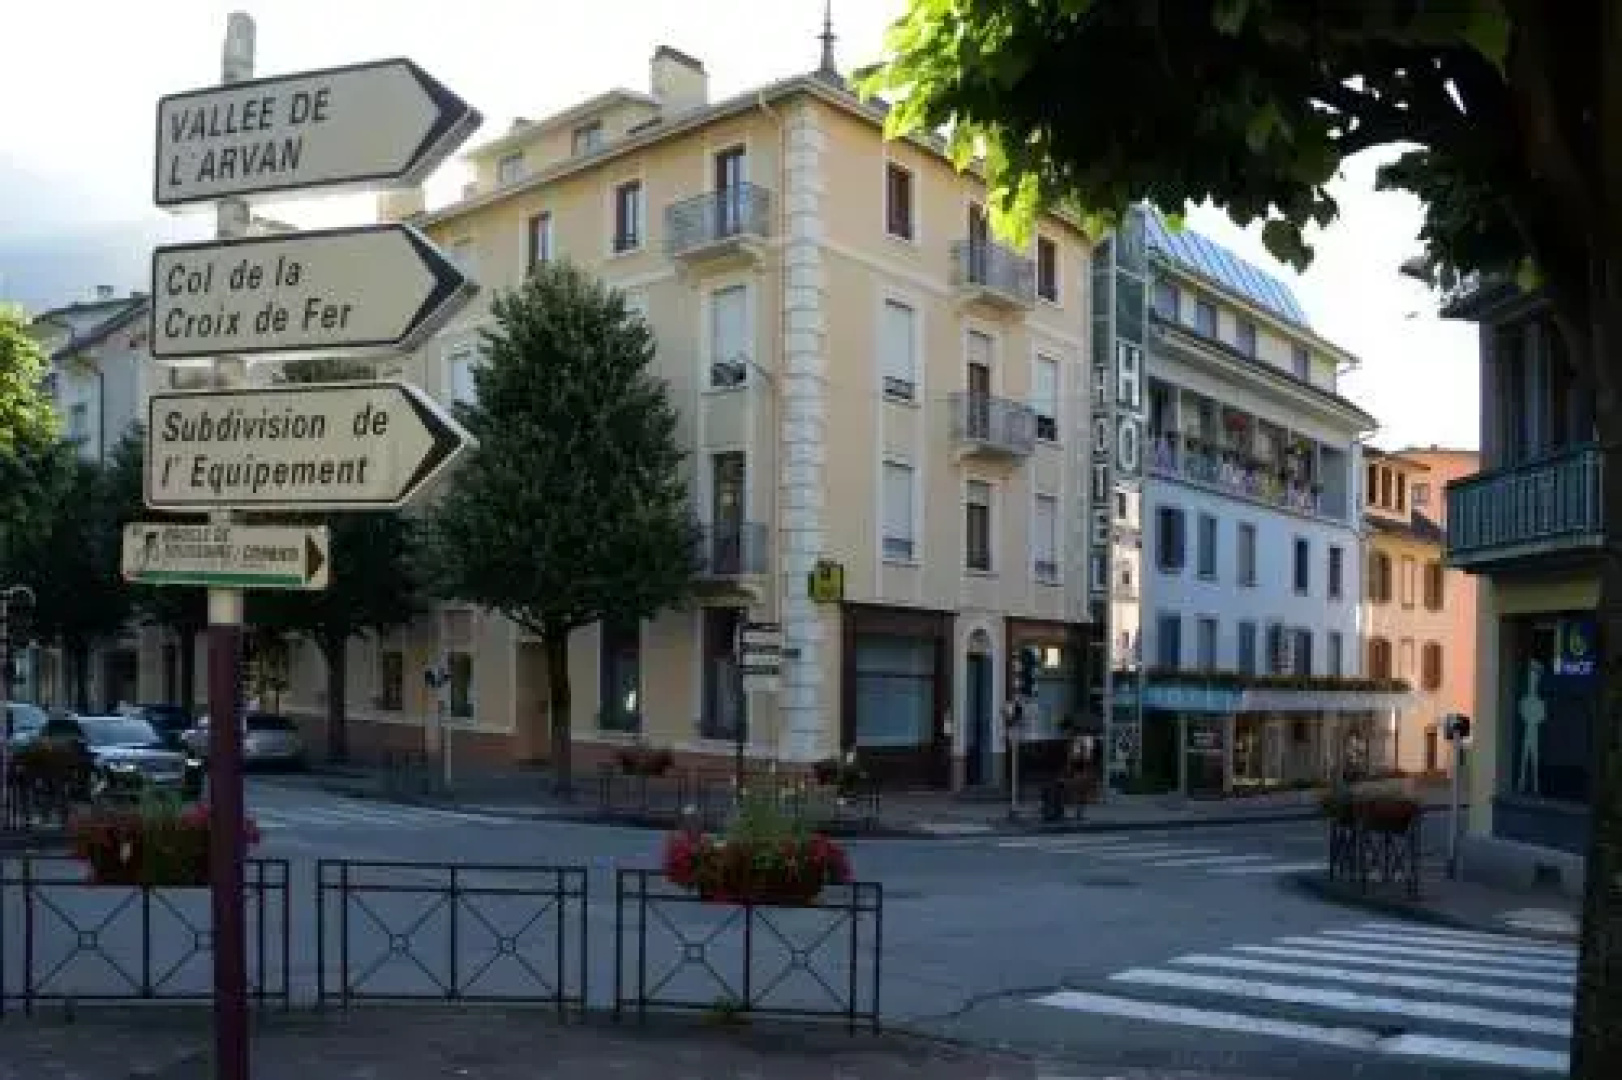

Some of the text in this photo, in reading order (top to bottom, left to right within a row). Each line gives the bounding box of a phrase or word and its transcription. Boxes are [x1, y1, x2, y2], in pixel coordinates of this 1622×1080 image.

[171, 88, 331, 142] VALLEE DE
[169, 138, 302, 185] L'ARVAN
[168, 256, 301, 295] Col de la
[165, 297, 352, 338] Croix de Fer
[162, 402, 390, 442] Subdivision de
